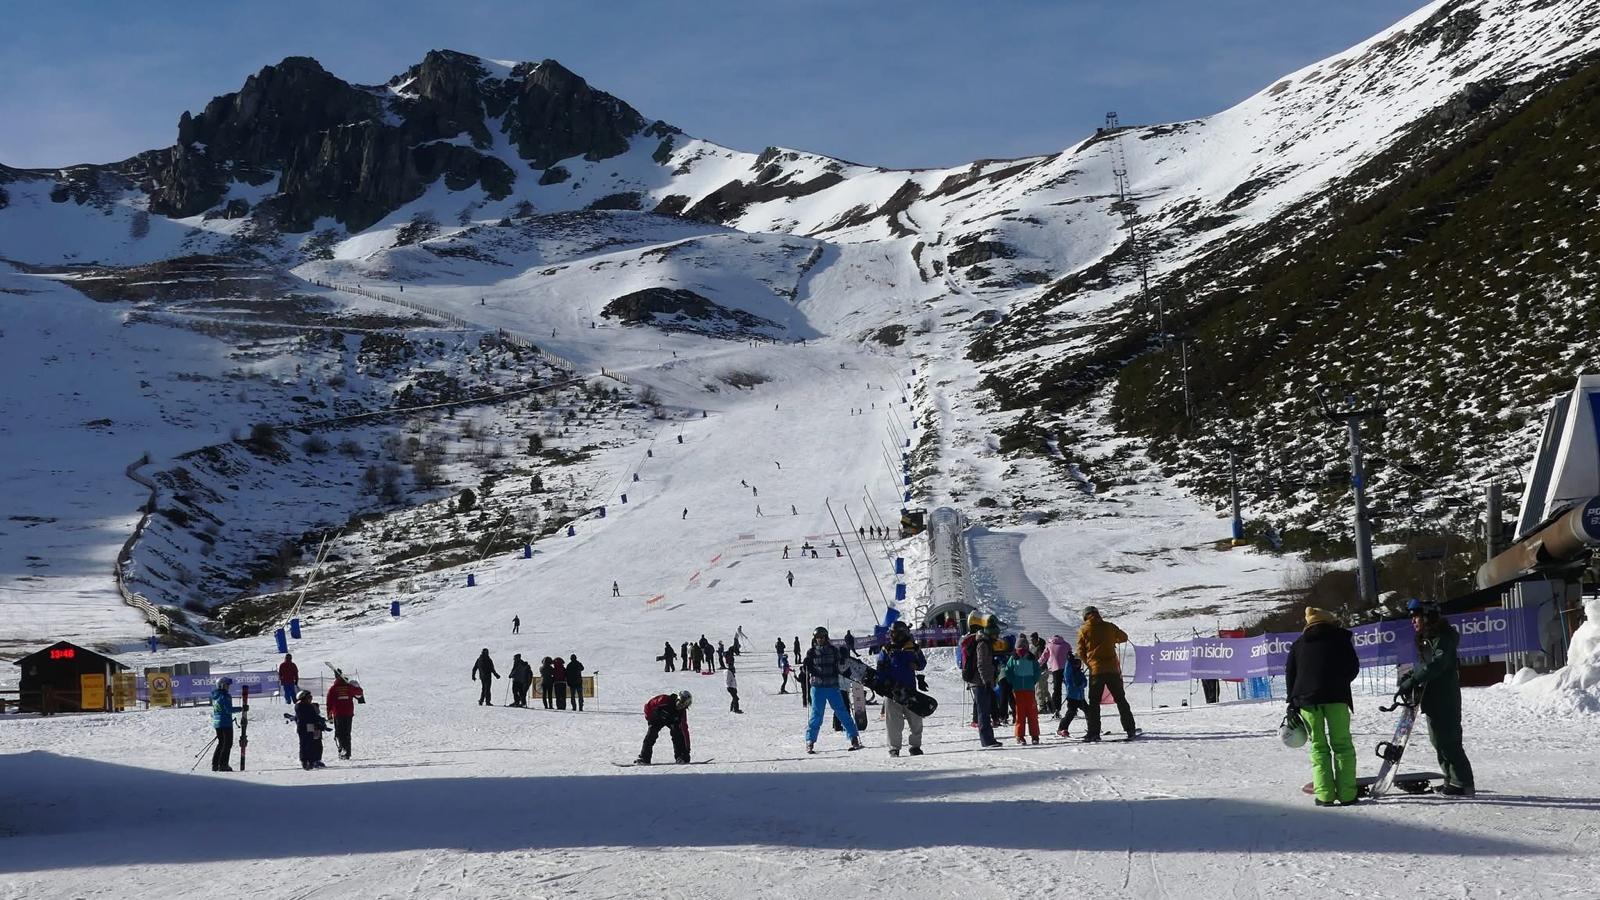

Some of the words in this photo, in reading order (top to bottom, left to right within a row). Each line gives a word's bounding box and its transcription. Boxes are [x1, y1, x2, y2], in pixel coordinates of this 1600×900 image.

[1461, 615, 1507, 635] isidro
[1354, 627, 1396, 647] isidro
[1159, 649, 1175, 661] san
[1204, 642, 1234, 659] isidro
